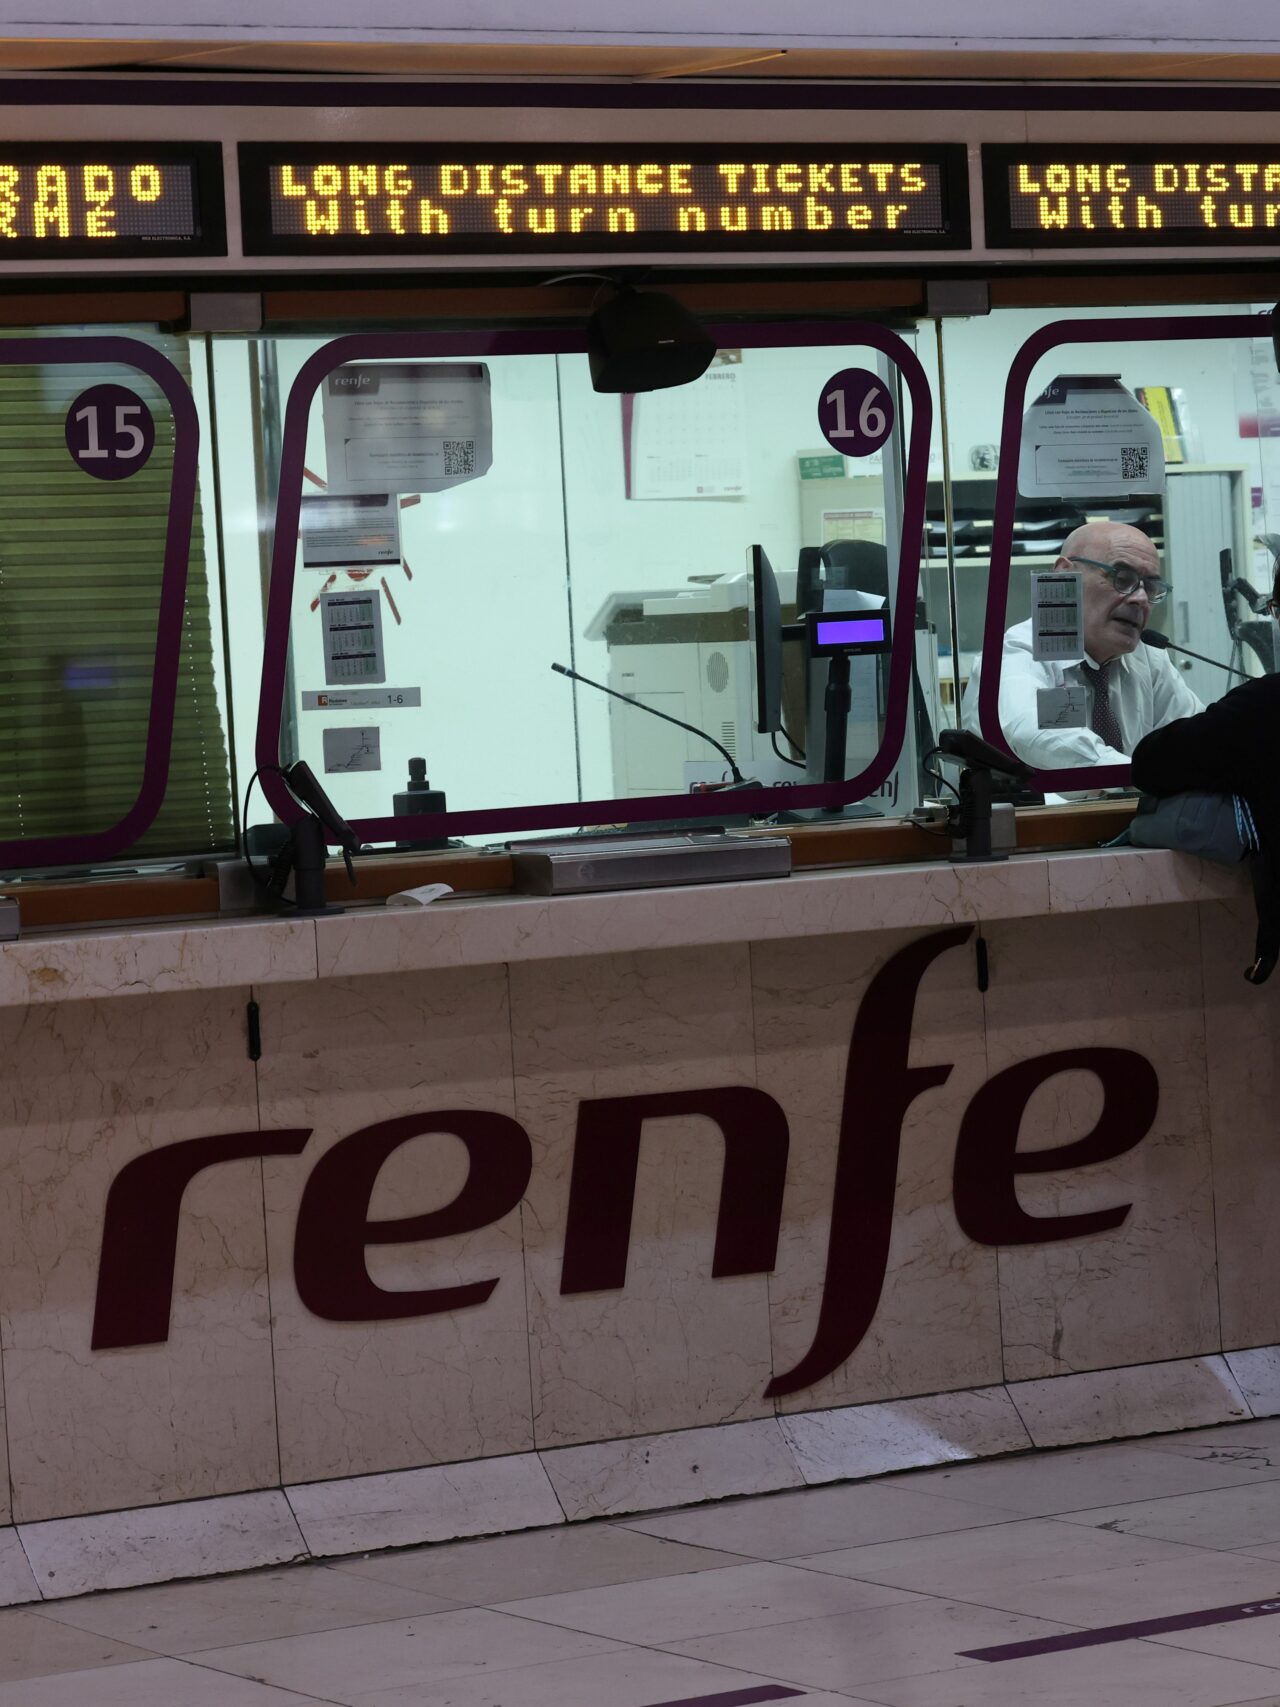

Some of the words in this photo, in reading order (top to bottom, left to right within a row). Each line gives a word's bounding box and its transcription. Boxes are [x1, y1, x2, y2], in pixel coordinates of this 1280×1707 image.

[282, 165, 412, 195] LONG
[441, 165, 692, 195] DISTANCE
[719, 164, 925, 193] TICKETS
[1019, 165, 1130, 192] LONG
[306, 199, 448, 235] With
[494, 199, 635, 233] turn
[679, 197, 907, 231] number
[1040, 196, 1161, 229] With
[335, 374, 371, 388] renfe
[826, 387, 886, 438] 16
[75, 406, 145, 459] 15
[387, 694, 404, 704] 1-6
[91, 925, 1160, 1400] renfe
